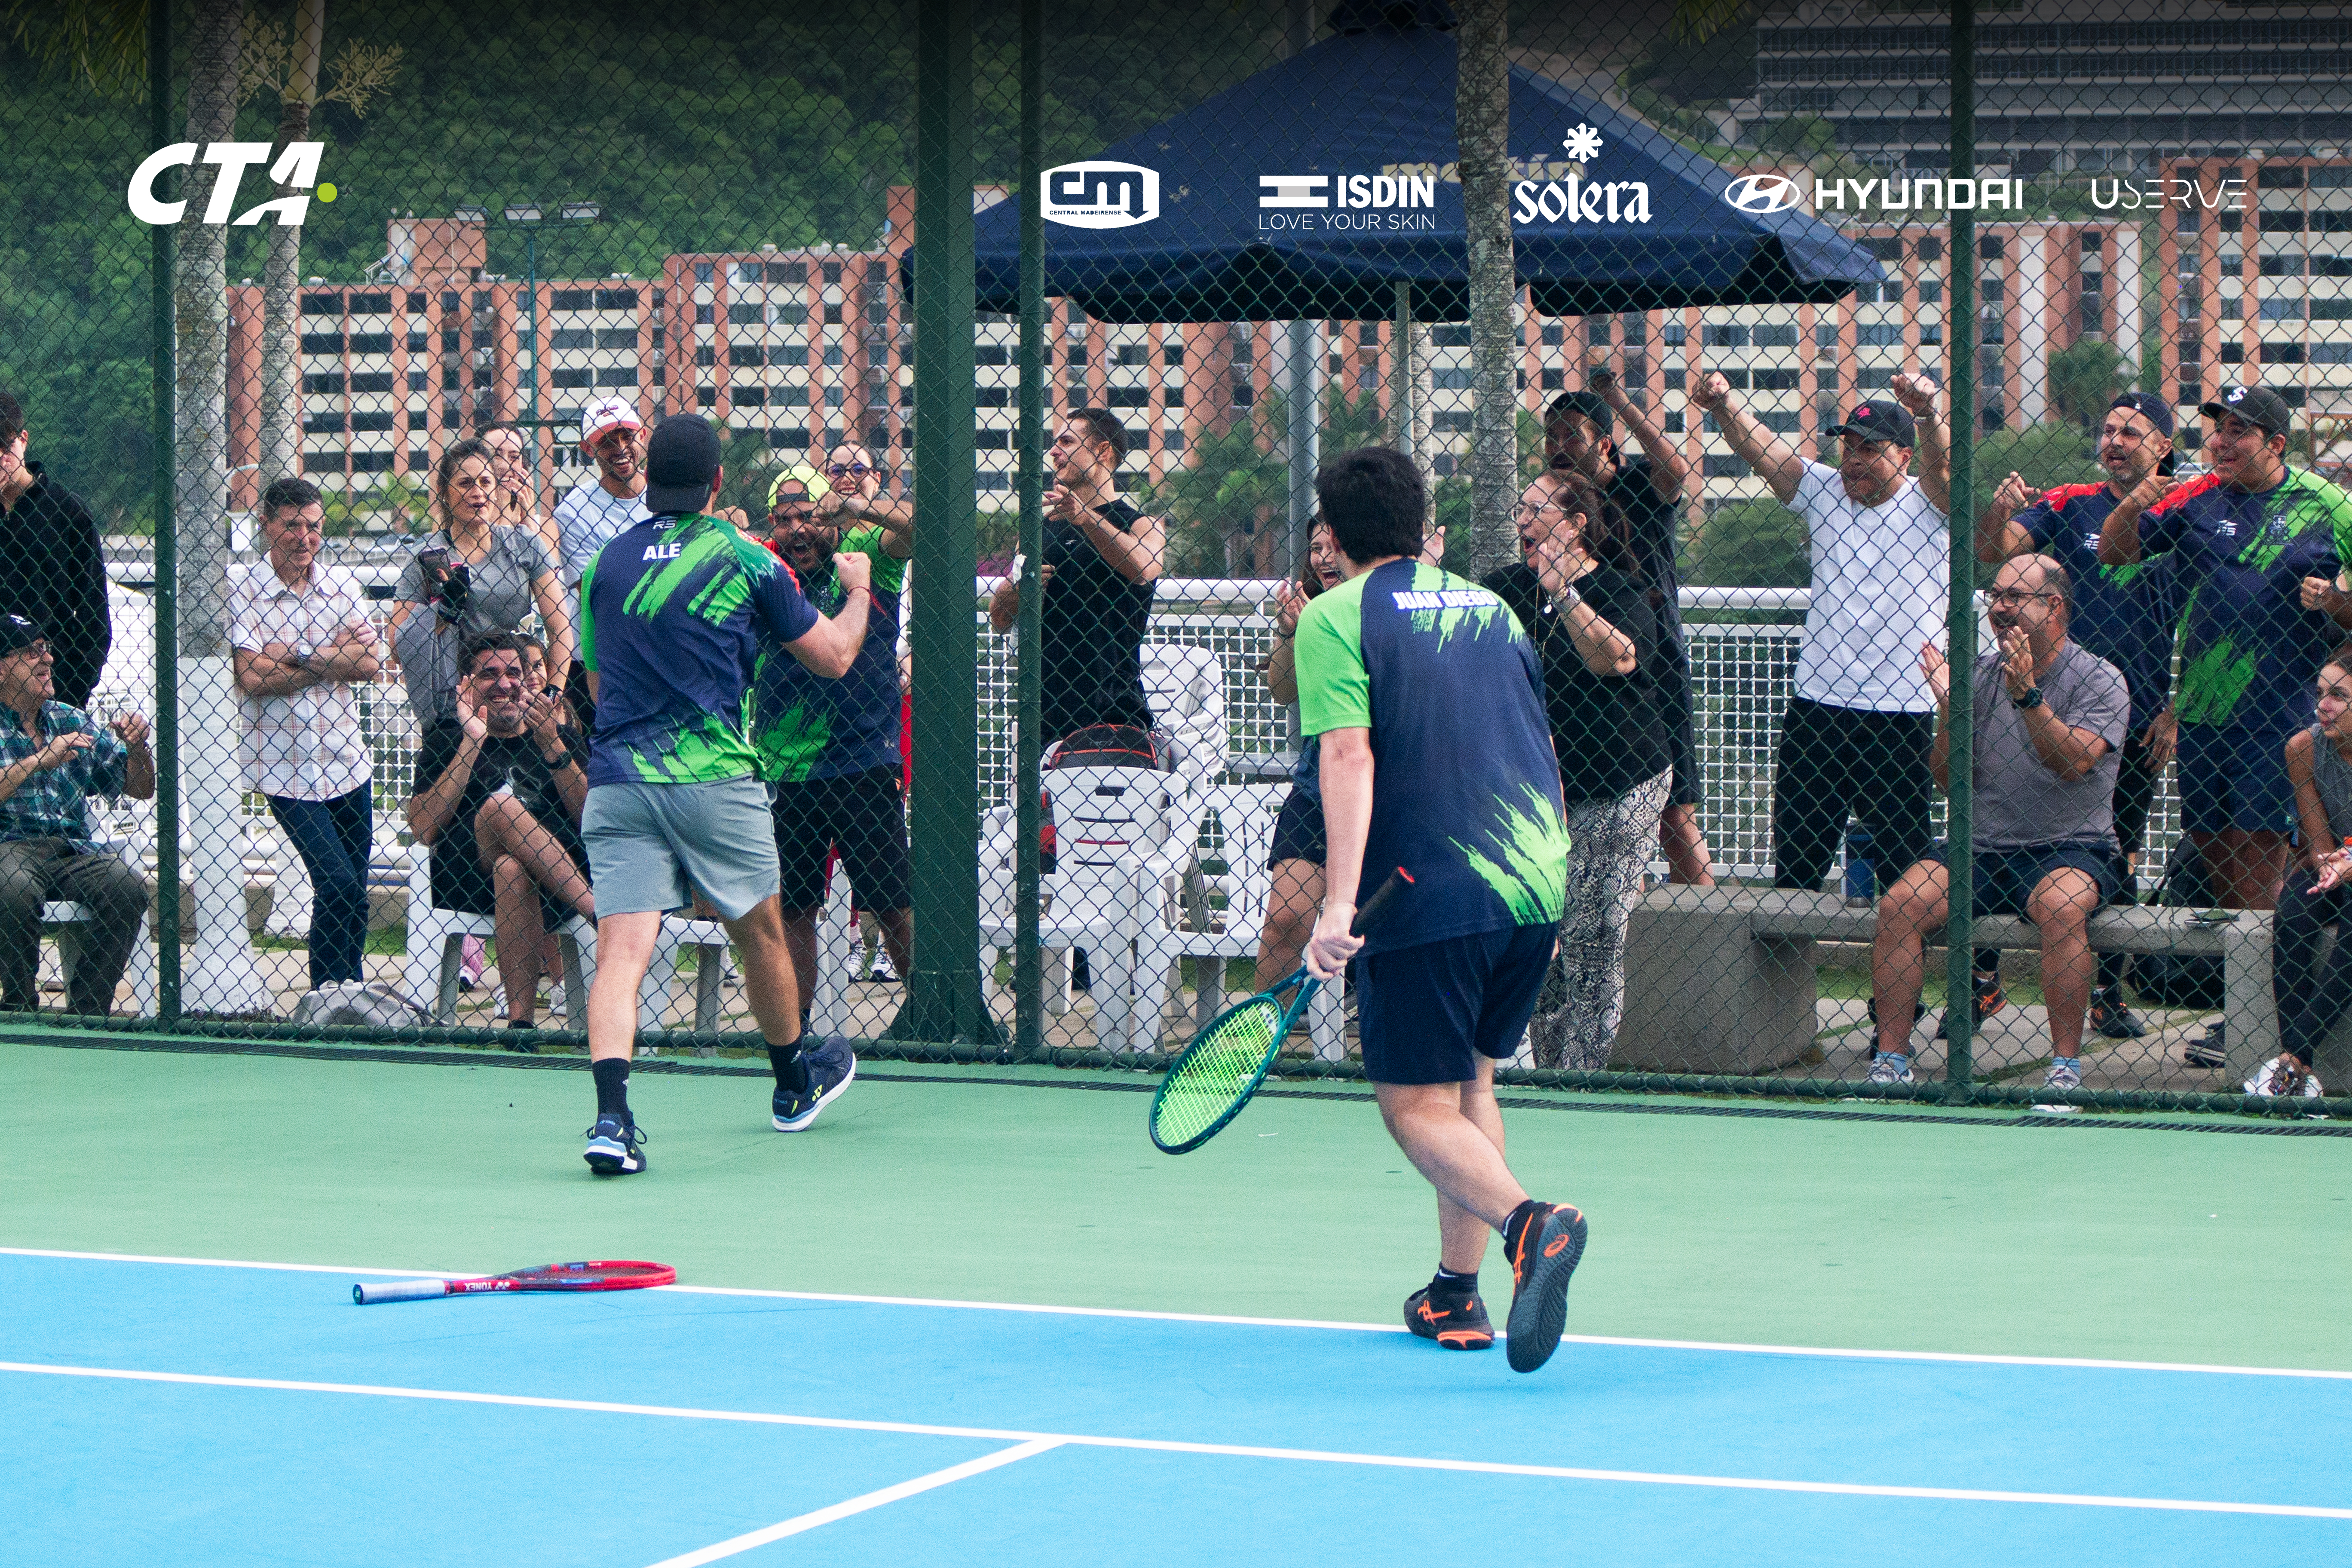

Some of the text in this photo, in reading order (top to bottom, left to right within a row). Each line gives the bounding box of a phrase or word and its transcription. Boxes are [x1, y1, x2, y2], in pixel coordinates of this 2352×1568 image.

[642, 543, 681, 560] ALE
[1392, 591, 1498, 609] JUAN DIEGO
[465, 1282, 491, 1291] YONEX
